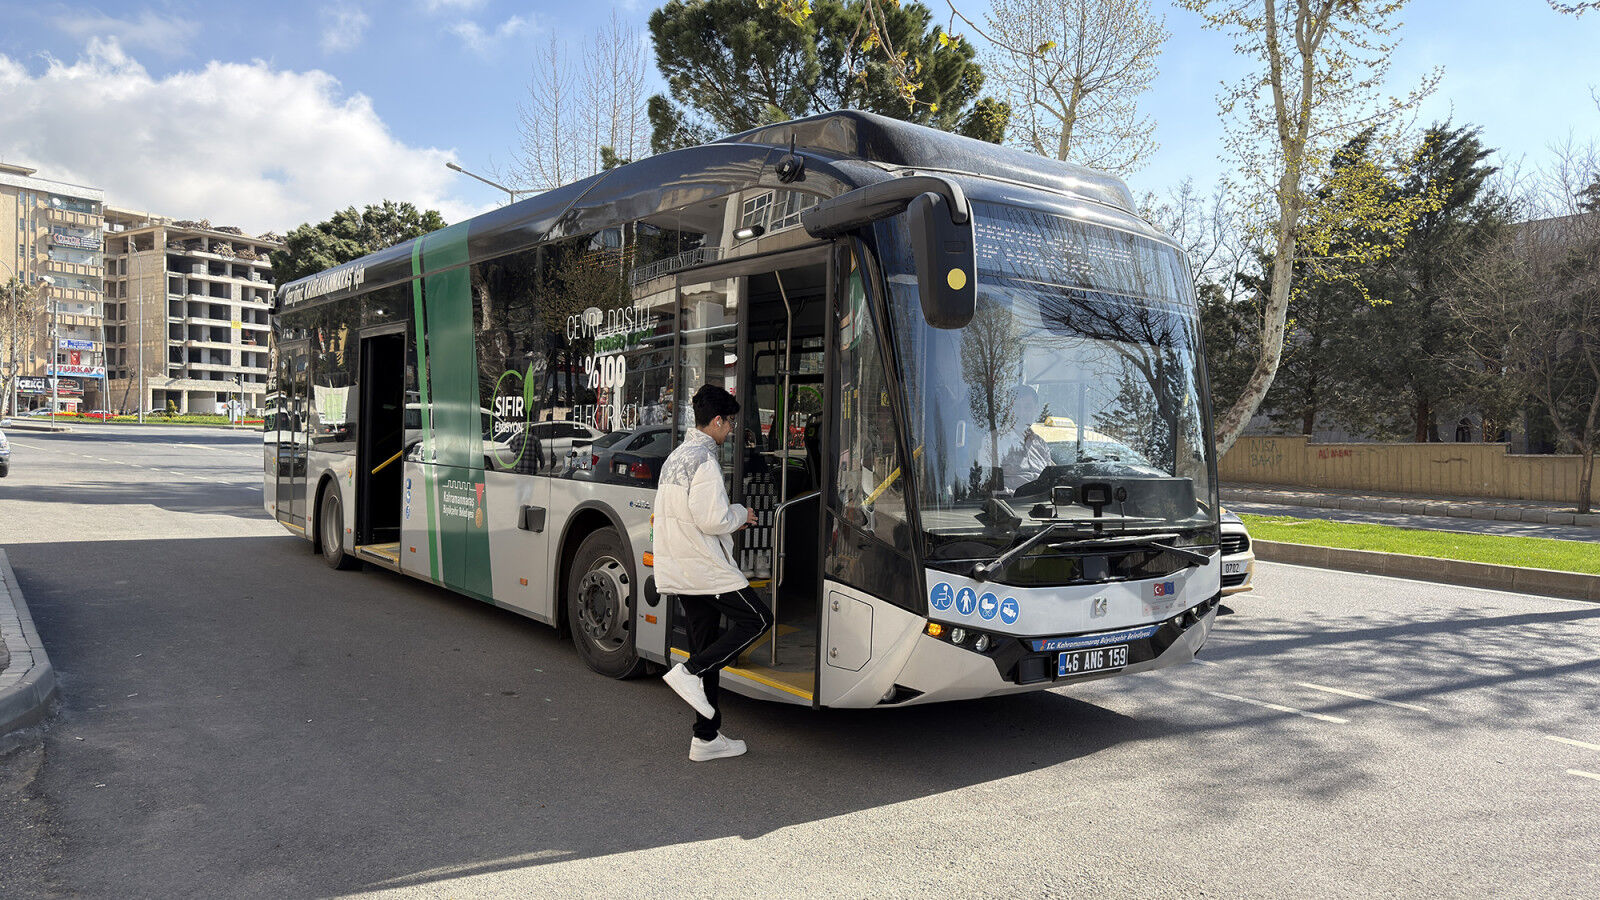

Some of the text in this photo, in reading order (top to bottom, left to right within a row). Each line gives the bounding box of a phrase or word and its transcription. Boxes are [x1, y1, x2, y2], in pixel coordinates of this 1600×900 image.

[567, 311, 603, 346] ÇEVRE
[608, 304, 650, 335] DOSTU
[585, 355, 626, 389] %100
[495, 396, 524, 417] SIFIR
[1066, 654, 1079, 672] 46
[1084, 650, 1103, 670] ANG
[1109, 648, 1126, 666] 159
